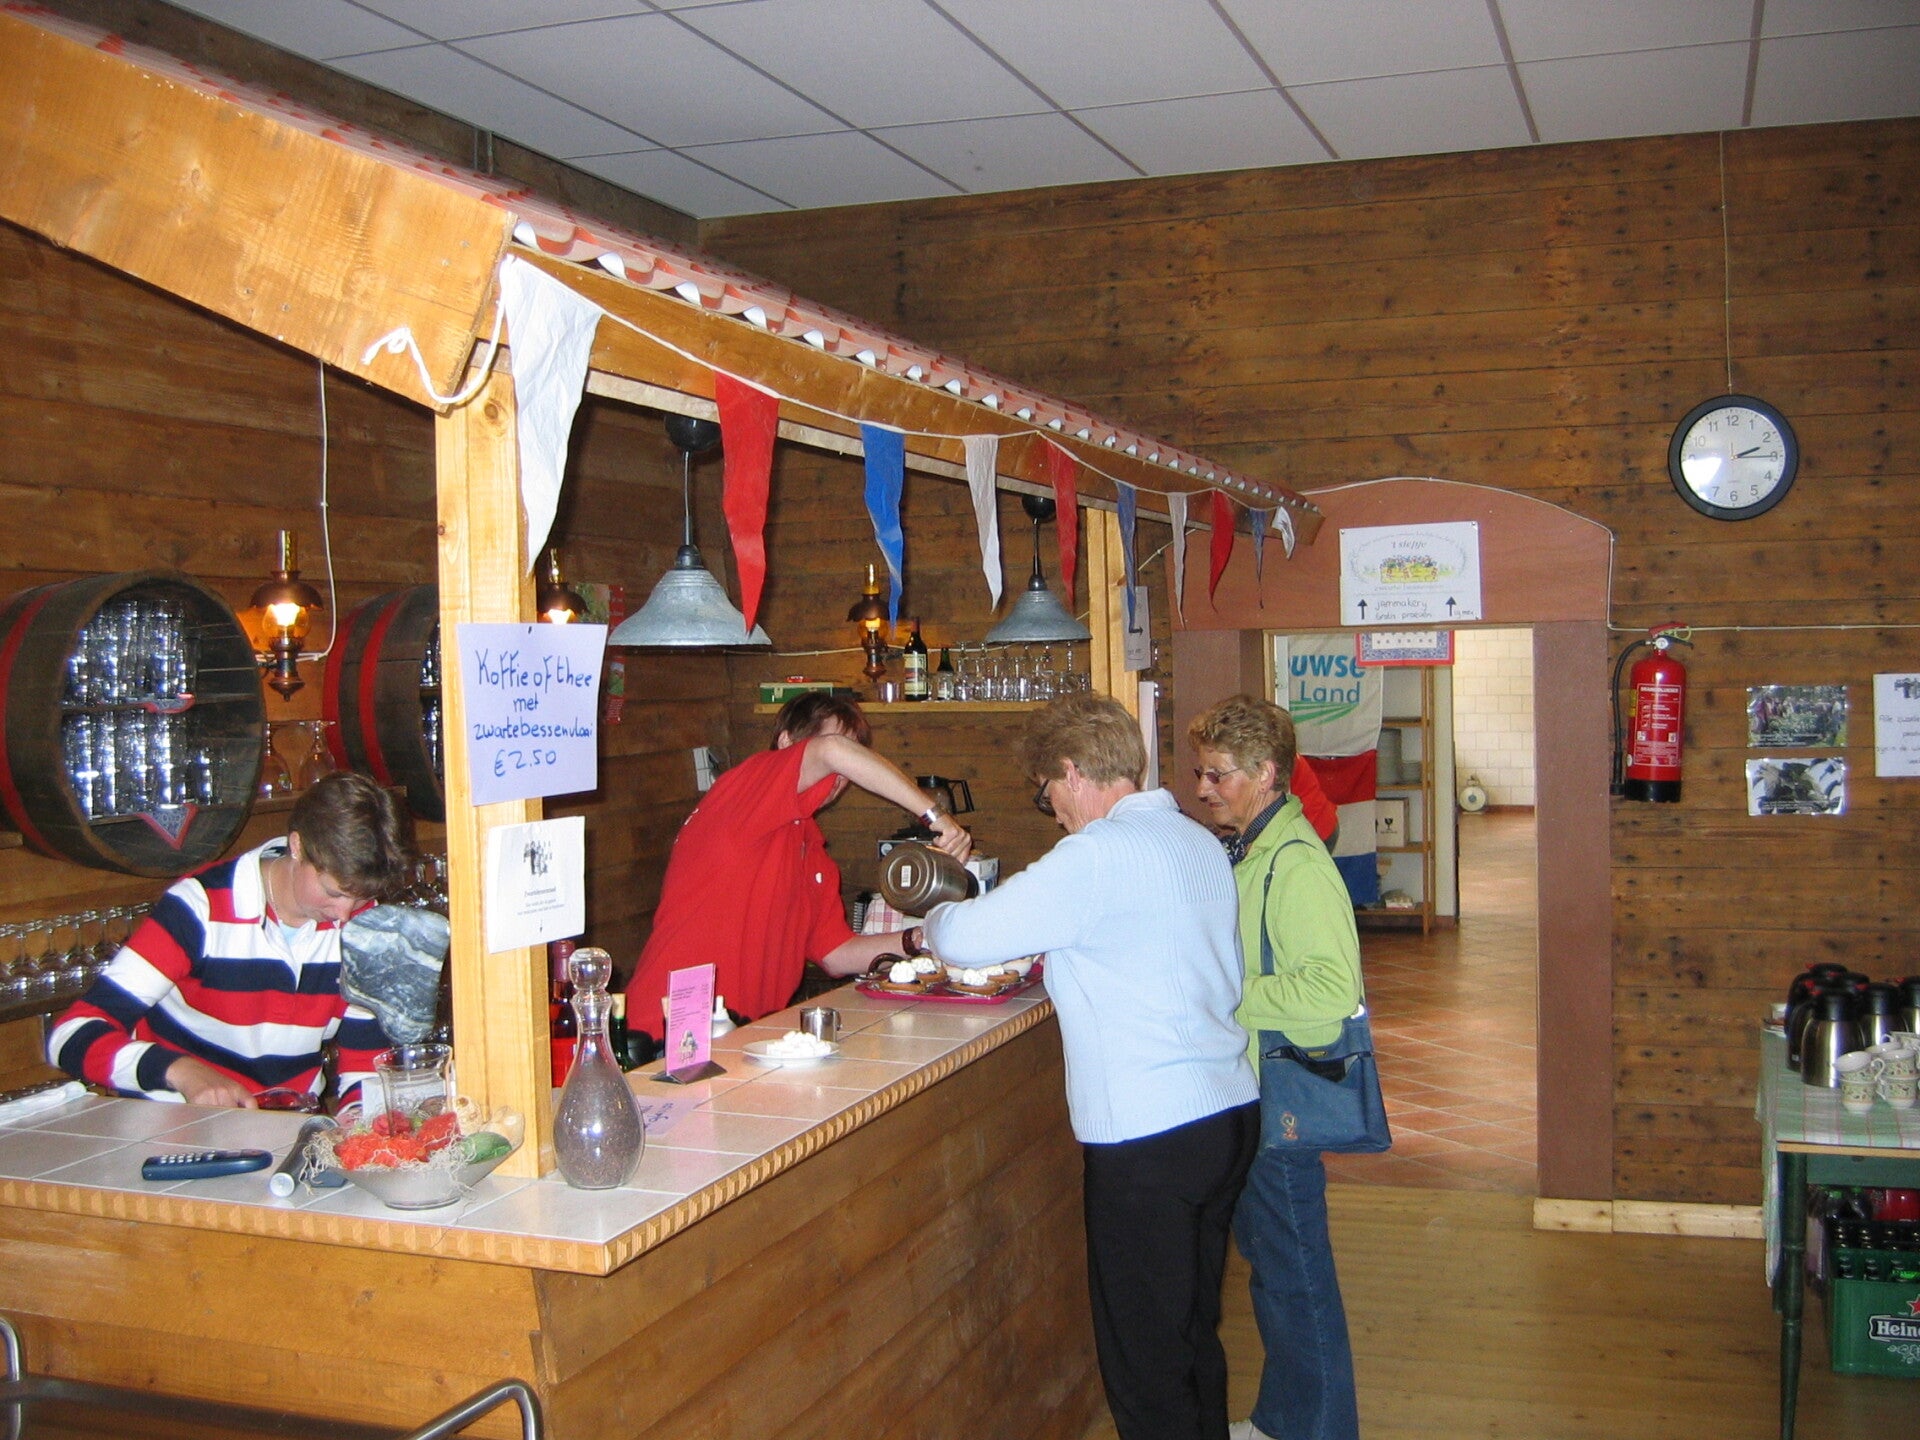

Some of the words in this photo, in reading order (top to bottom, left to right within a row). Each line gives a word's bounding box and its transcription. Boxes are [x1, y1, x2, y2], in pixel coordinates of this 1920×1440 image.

[1708, 421, 1719, 432] 11
[1725, 414, 1739, 427] 12
[1749, 419, 1754, 430] 1
[1694, 435, 1706, 447] 10
[1762, 432, 1771, 443] 2
[1770, 451, 1777, 462] 3
[1764, 471, 1771, 481] 4
[1712, 486, 1720, 497] 7
[1729, 490, 1738, 502] 6
[1750, 484, 1758, 496] 5
[475, 648, 529, 690] Koffie
[533, 655, 553, 694] of
[556, 655, 592, 687] thee
[1301, 680, 1361, 705] Land
[513, 692, 539, 713] met
[1877, 1321, 1920, 1337] Hein
